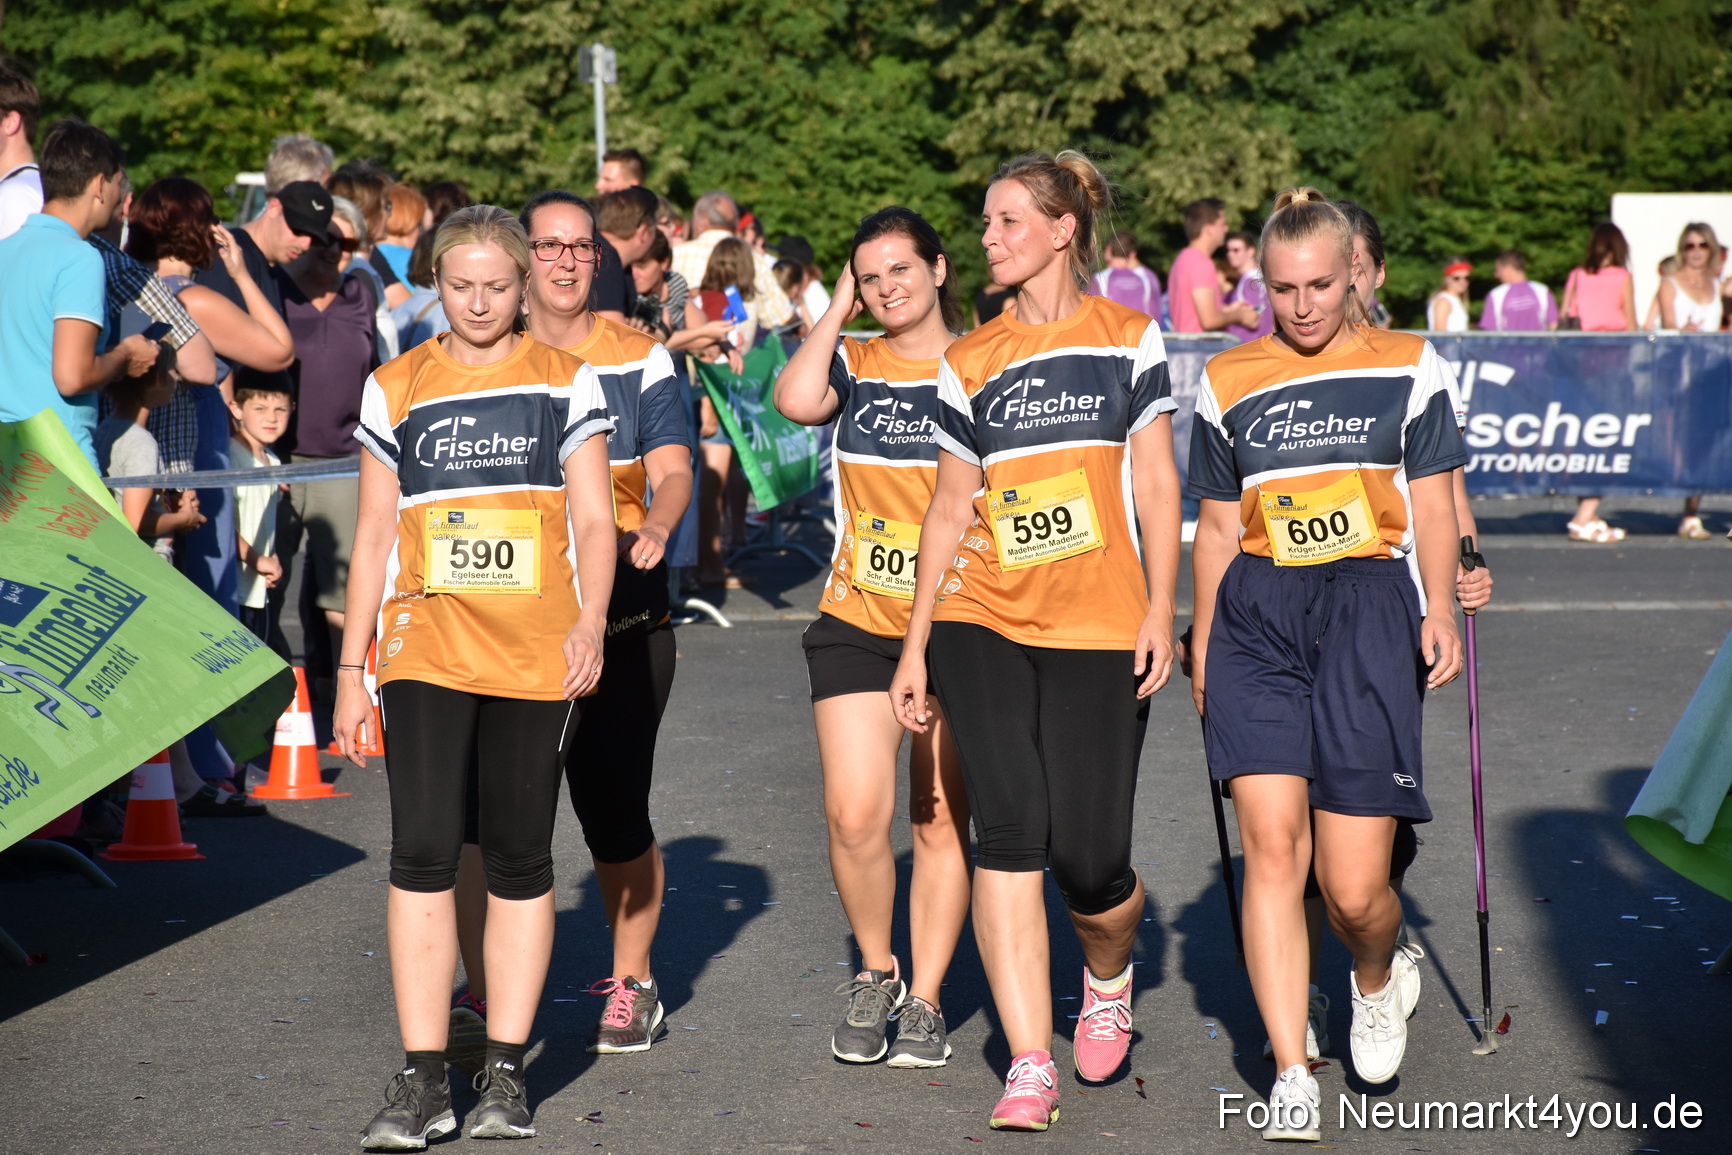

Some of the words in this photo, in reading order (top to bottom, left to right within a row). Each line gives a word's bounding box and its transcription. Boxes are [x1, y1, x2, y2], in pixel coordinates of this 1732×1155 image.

[1004, 391, 1105, 420] Fischer
[873, 413, 936, 434] Fisch
[1014, 412, 1099, 431] AUTOMOBILE
[1267, 413, 1377, 440] Fischer
[1463, 402, 1652, 448] scher
[434, 432, 538, 460] Fischer
[879, 434, 937, 445] AUTOMOB
[1277, 430, 1368, 451] AUTOMOBILE
[444, 455, 529, 471] AUTOMOBILE
[1464, 453, 1632, 474] UTOMOBILE
[1273, 504, 1308, 512] firmenlauf
[441, 522, 479, 530] firmenlauf
[1013, 506, 1072, 544] 599
[1287, 511, 1349, 545] 600
[1008, 543, 1047, 556] Madeheim
[1049, 530, 1089, 546] Madeleine
[1015, 553, 1034, 561] Fischer
[1035, 546, 1066, 557] Automobile
[1067, 540, 1084, 549] GmbH
[1311, 547, 1344, 557] Automobile
[1345, 539, 1361, 549] GmbH
[1318, 531, 1360, 551] Lisa-Marie
[450, 540, 514, 570] 590
[870, 544, 919, 578] 601
[452, 571, 489, 580] Egelseer
[492, 571, 513, 579] Lena
[864, 578, 880, 586] Fischer
[881, 581, 910, 592] Automobile
[895, 578, 915, 587] Stefa
[0, 554, 141, 676] firmenlauf
[607, 608, 652, 637] Volbeat
[86, 643, 140, 702] neumarkt
